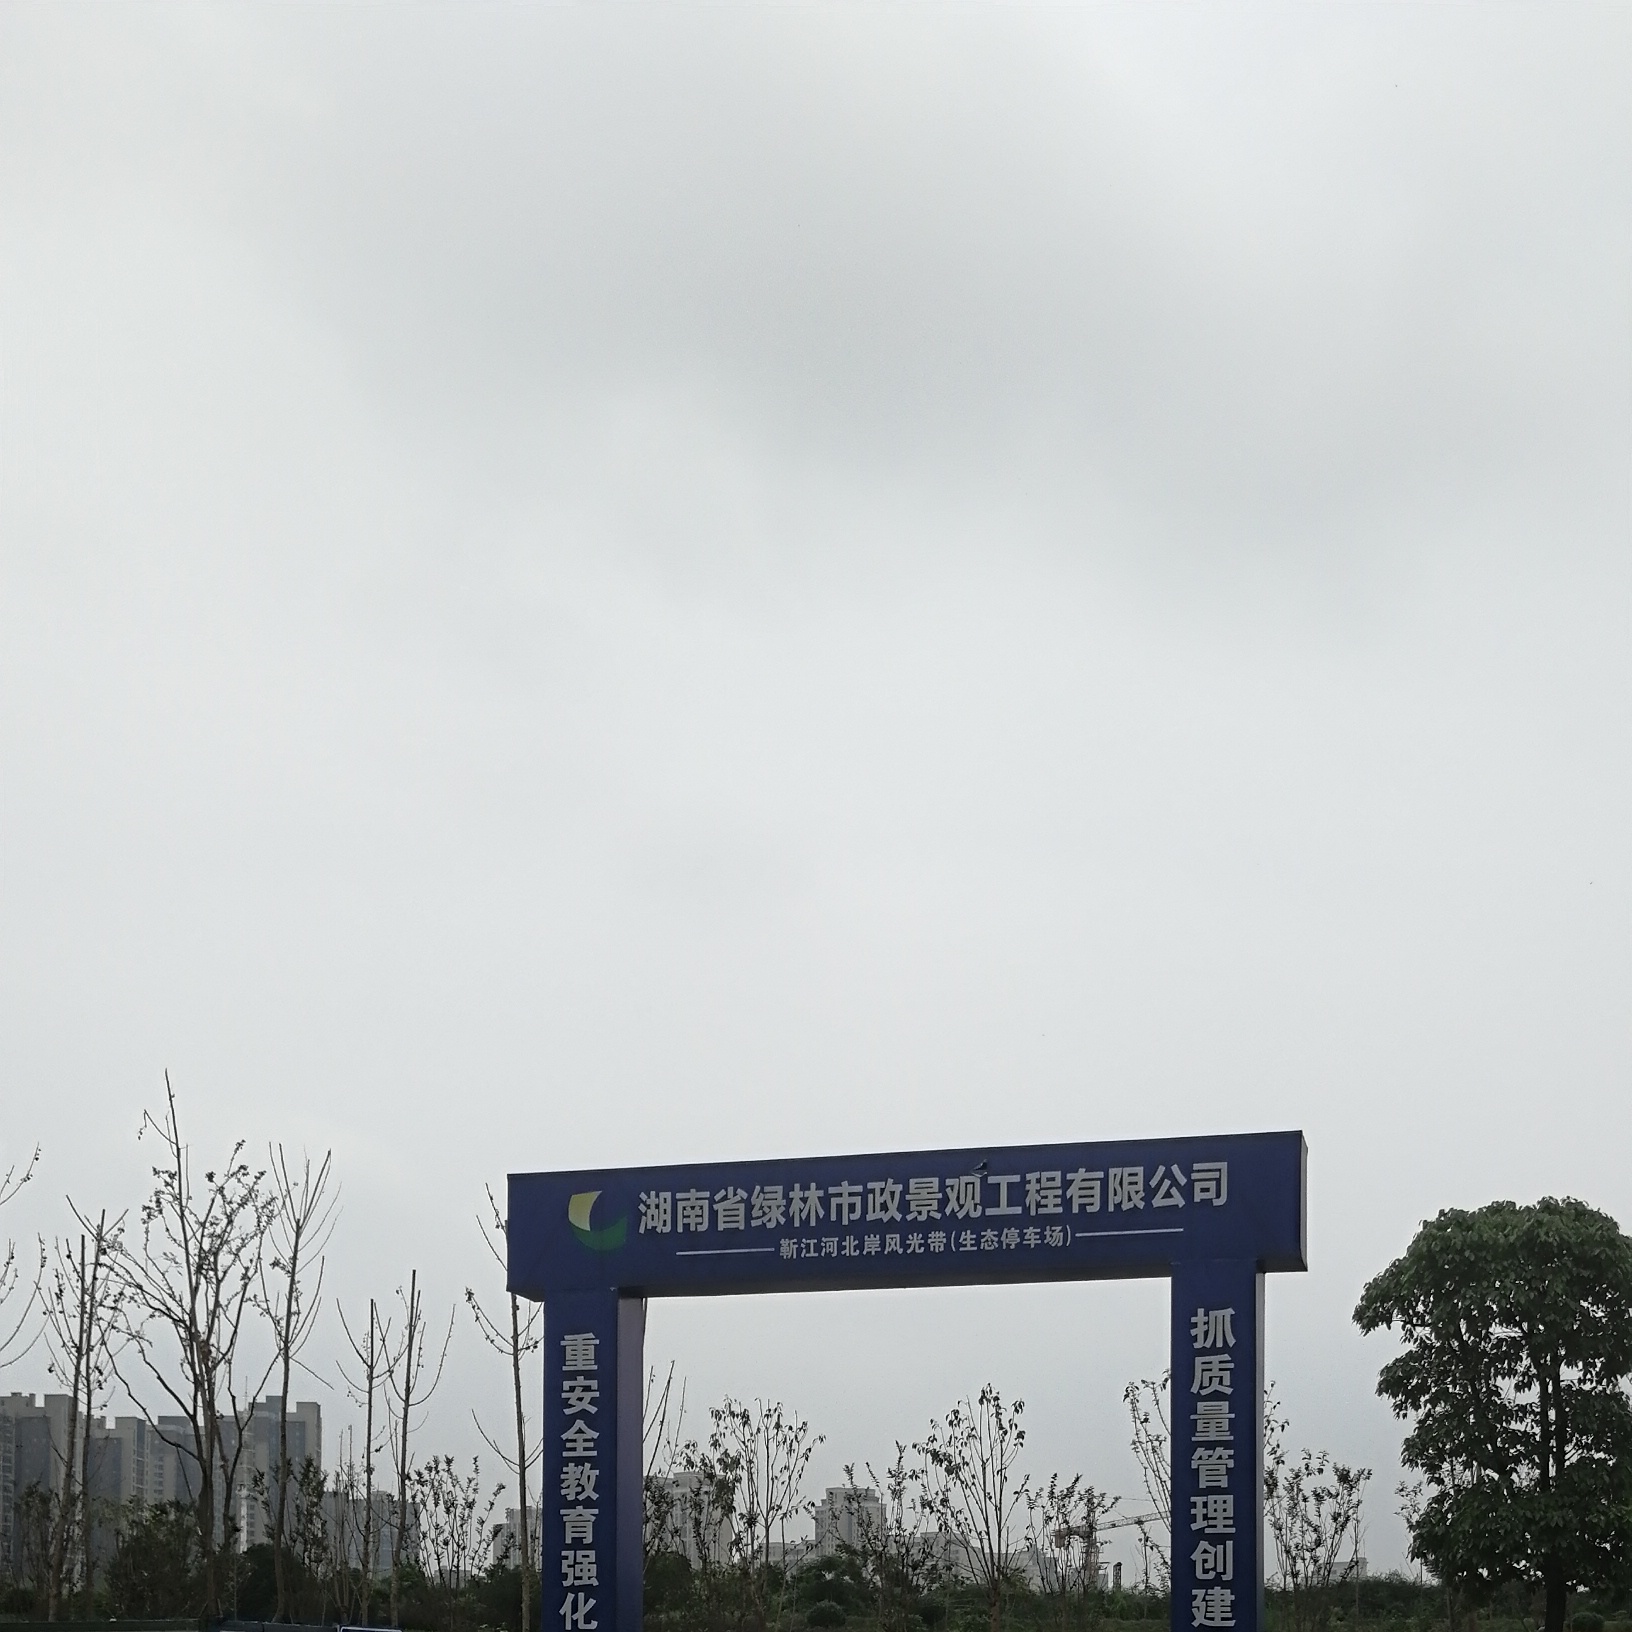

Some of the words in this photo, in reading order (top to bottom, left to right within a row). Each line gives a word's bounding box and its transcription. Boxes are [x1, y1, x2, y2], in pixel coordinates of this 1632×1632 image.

[638, 1161, 1230, 1235] 湖南省绿林市政景观工程有限公司
